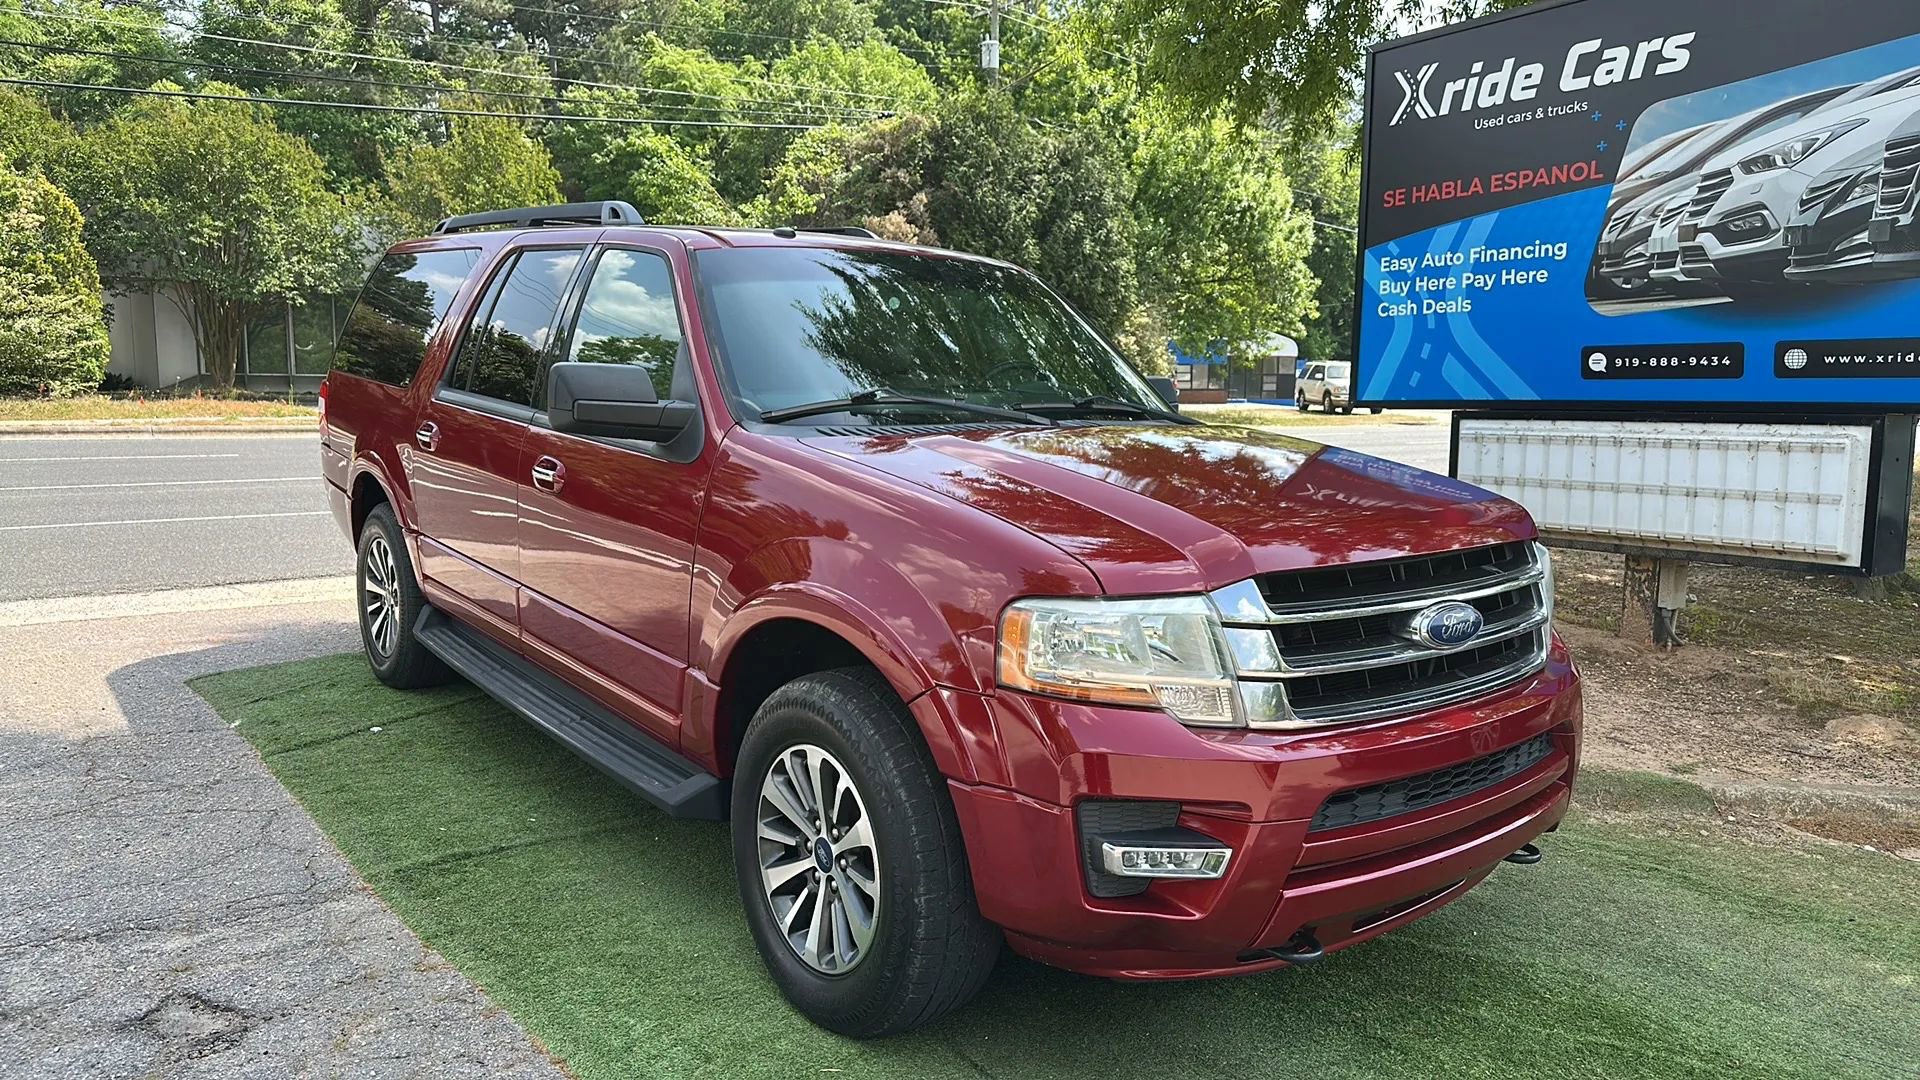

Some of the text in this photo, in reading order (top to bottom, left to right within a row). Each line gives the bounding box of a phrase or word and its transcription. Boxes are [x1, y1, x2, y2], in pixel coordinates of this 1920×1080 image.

[1559, 31, 1696, 92] Cars
[1474, 100, 1588, 130] Used cars & trucks
[1383, 160, 1604, 208] SE HABLA ESPANOL
[1380, 239, 1568, 276] Easy Auto Financing
[1379, 267, 1548, 298] Buy Here Pay Here
[1377, 297, 1472, 318] Cash Deals
[1614, 355, 1732, 368] 919-888-9434
[1823, 352, 1920, 364] www.xrid
[1441, 611, 1477, 639] Ford
